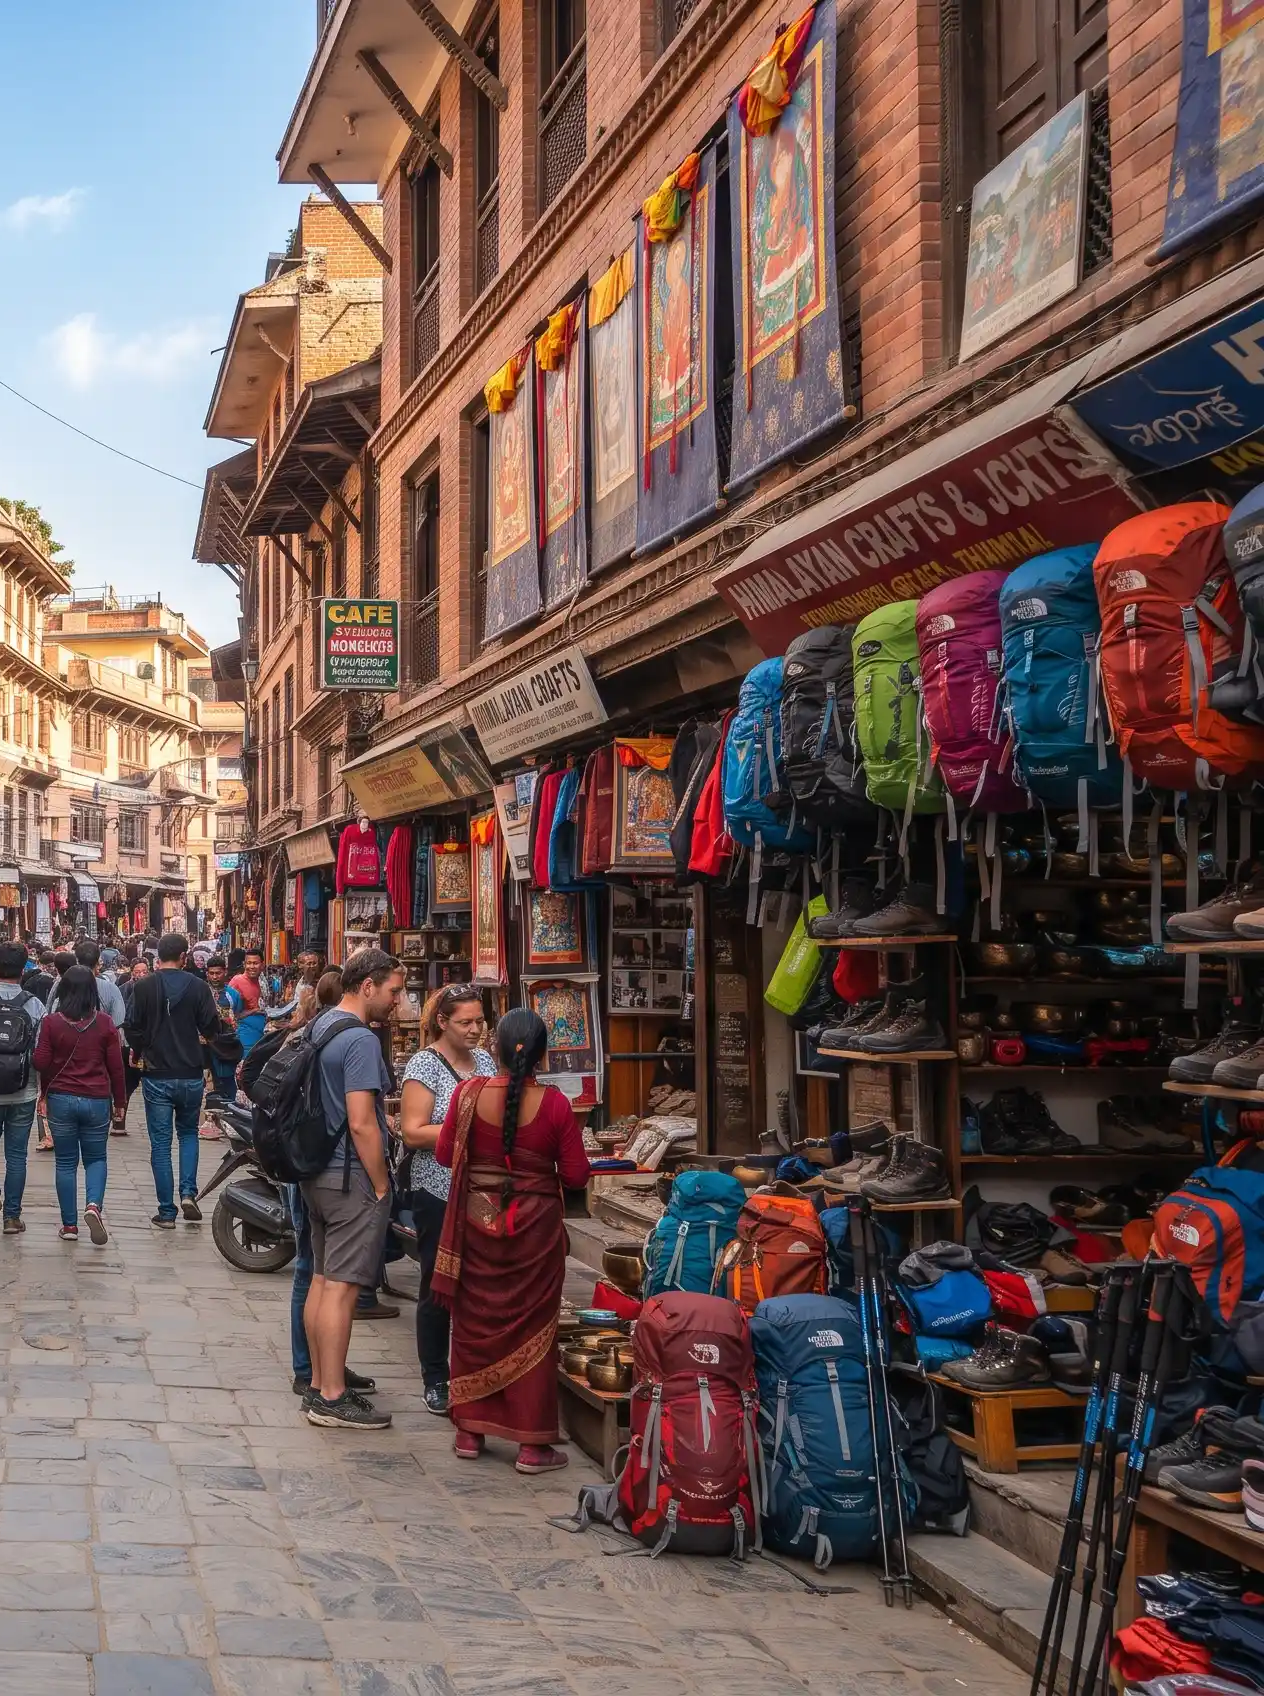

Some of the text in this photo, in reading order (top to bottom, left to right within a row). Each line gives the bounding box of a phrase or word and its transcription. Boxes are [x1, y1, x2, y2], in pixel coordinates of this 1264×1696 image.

[727, 538, 861, 621] HIMALAYAN
[844, 491, 956, 569] CRAFTS
[942, 480, 988, 527] &
[327, 605, 393, 624] CAFE
